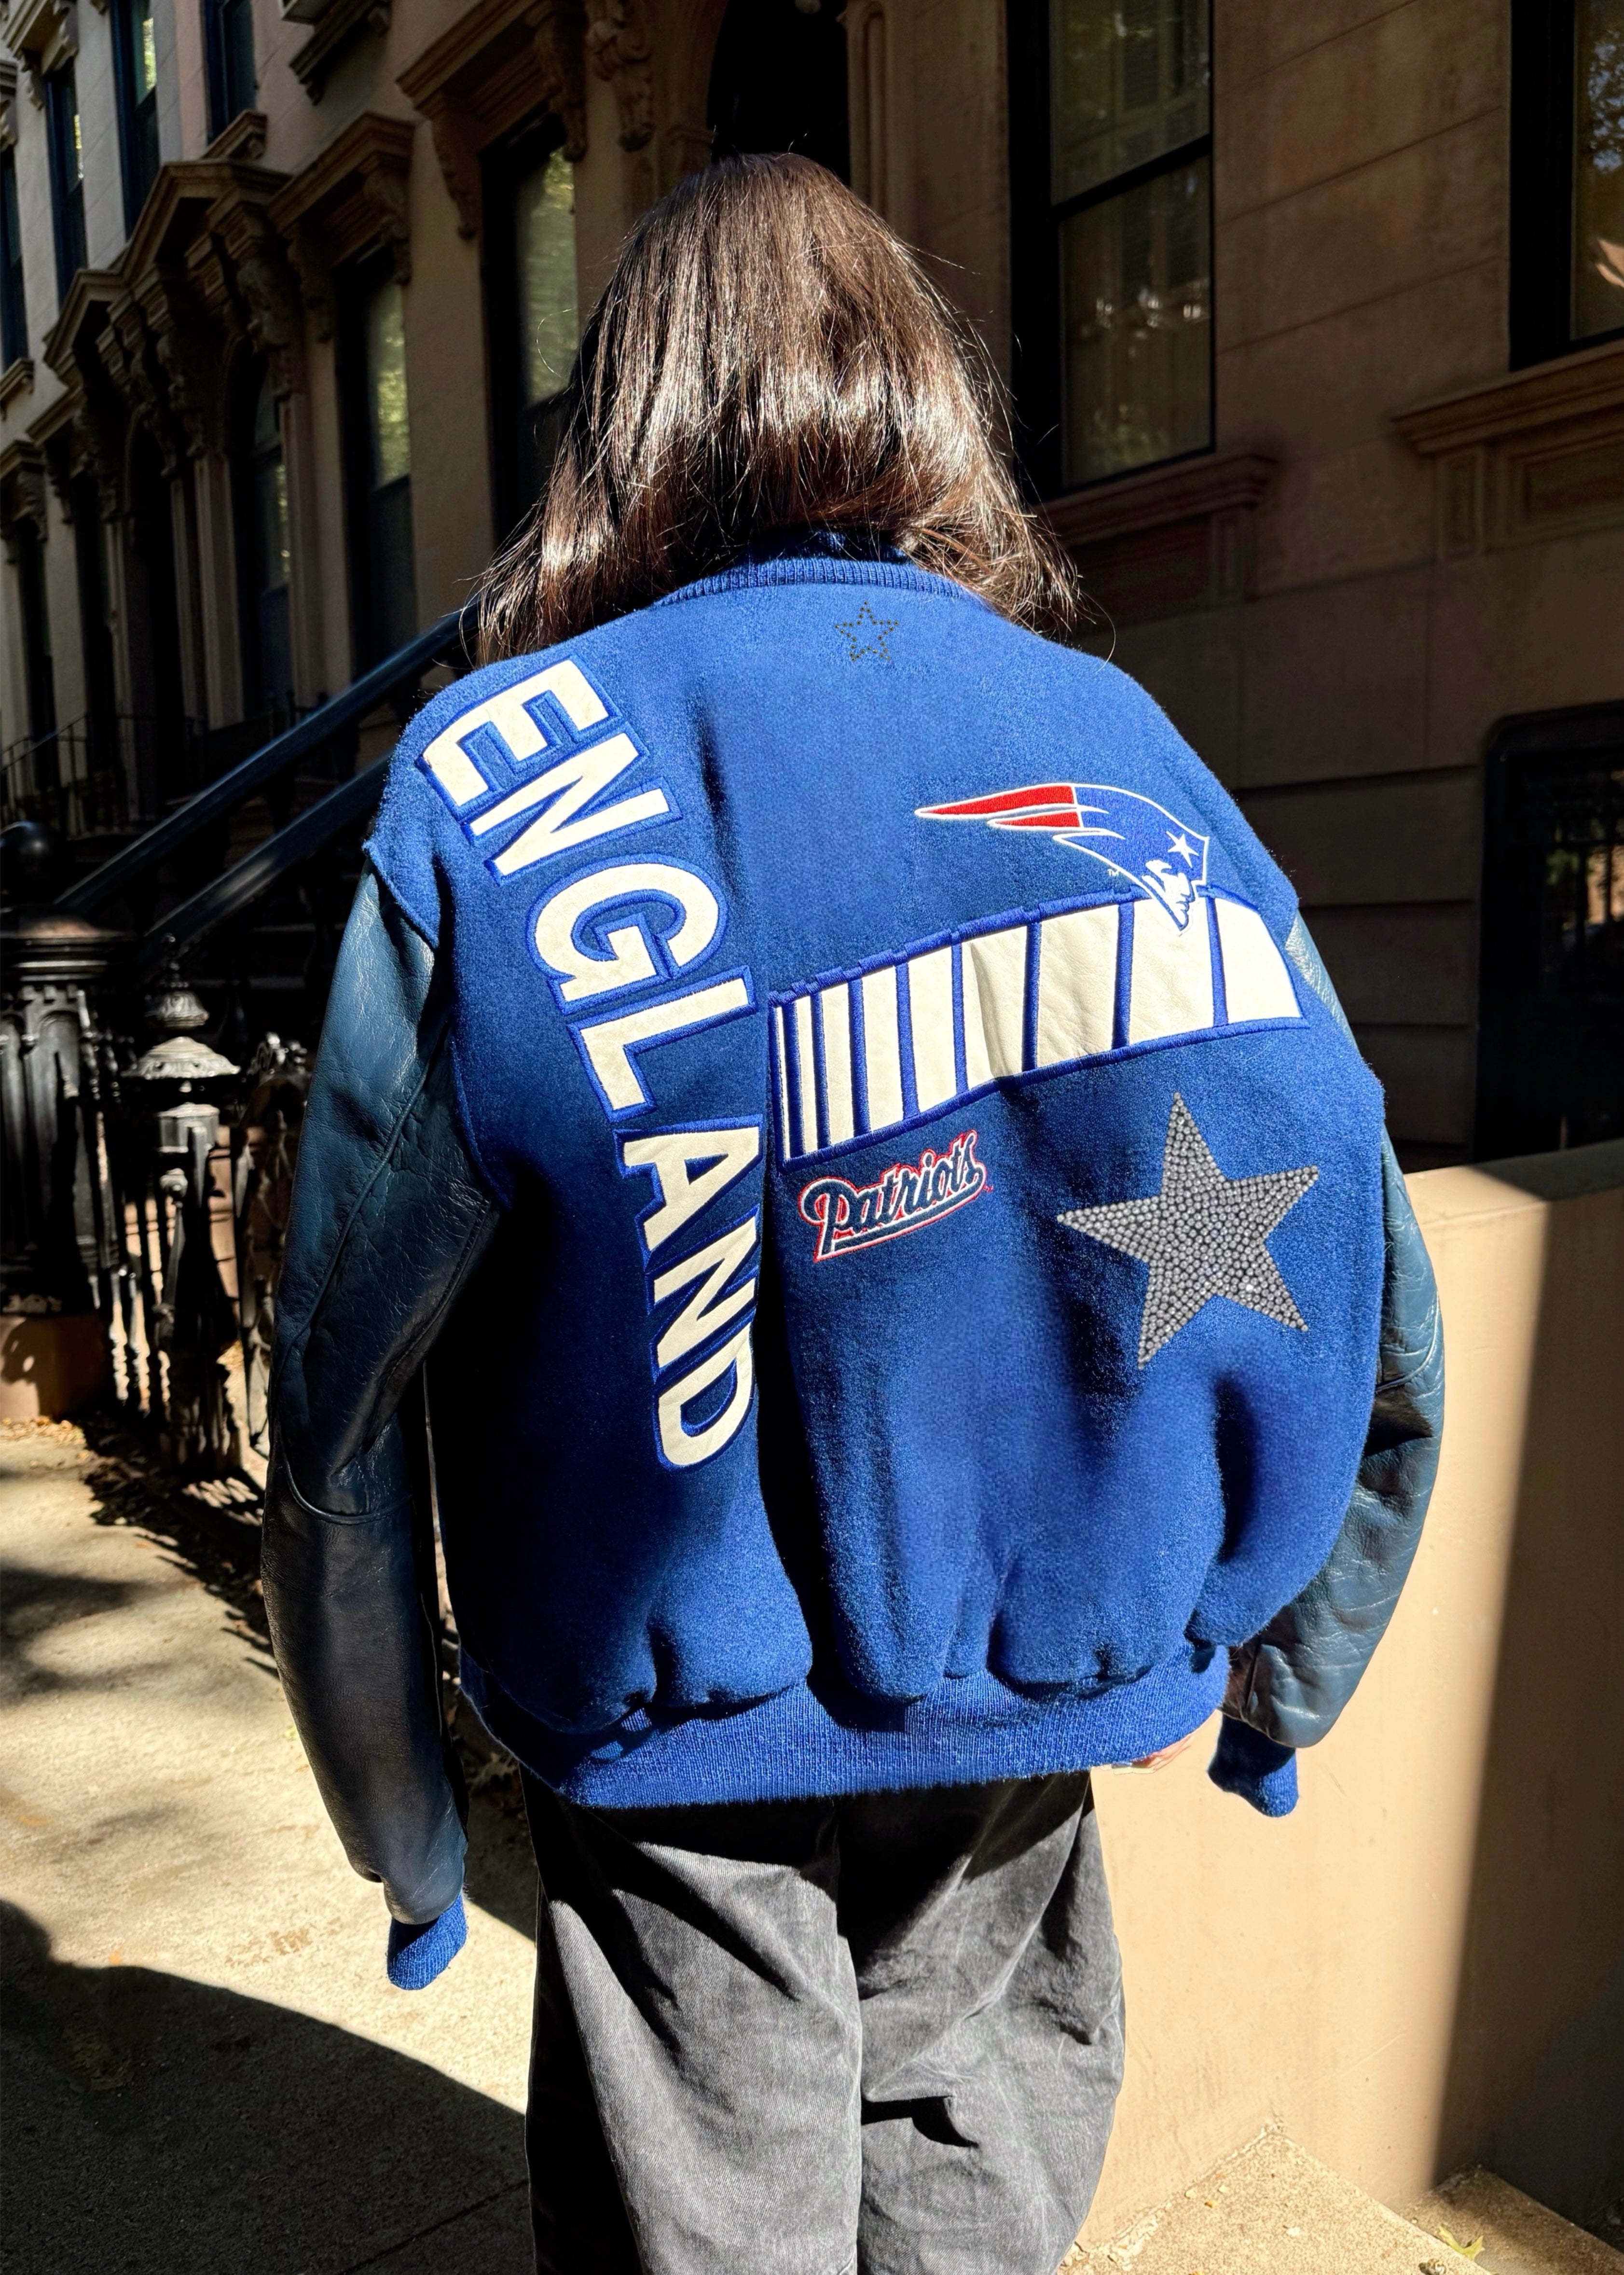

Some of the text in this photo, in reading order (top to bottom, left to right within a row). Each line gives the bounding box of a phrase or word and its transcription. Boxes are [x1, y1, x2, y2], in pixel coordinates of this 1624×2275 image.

[1107, 869, 1119, 877] TM
[418, 656, 761, 1468] ENGLAND
[798, 1130, 987, 1262] Patriots
